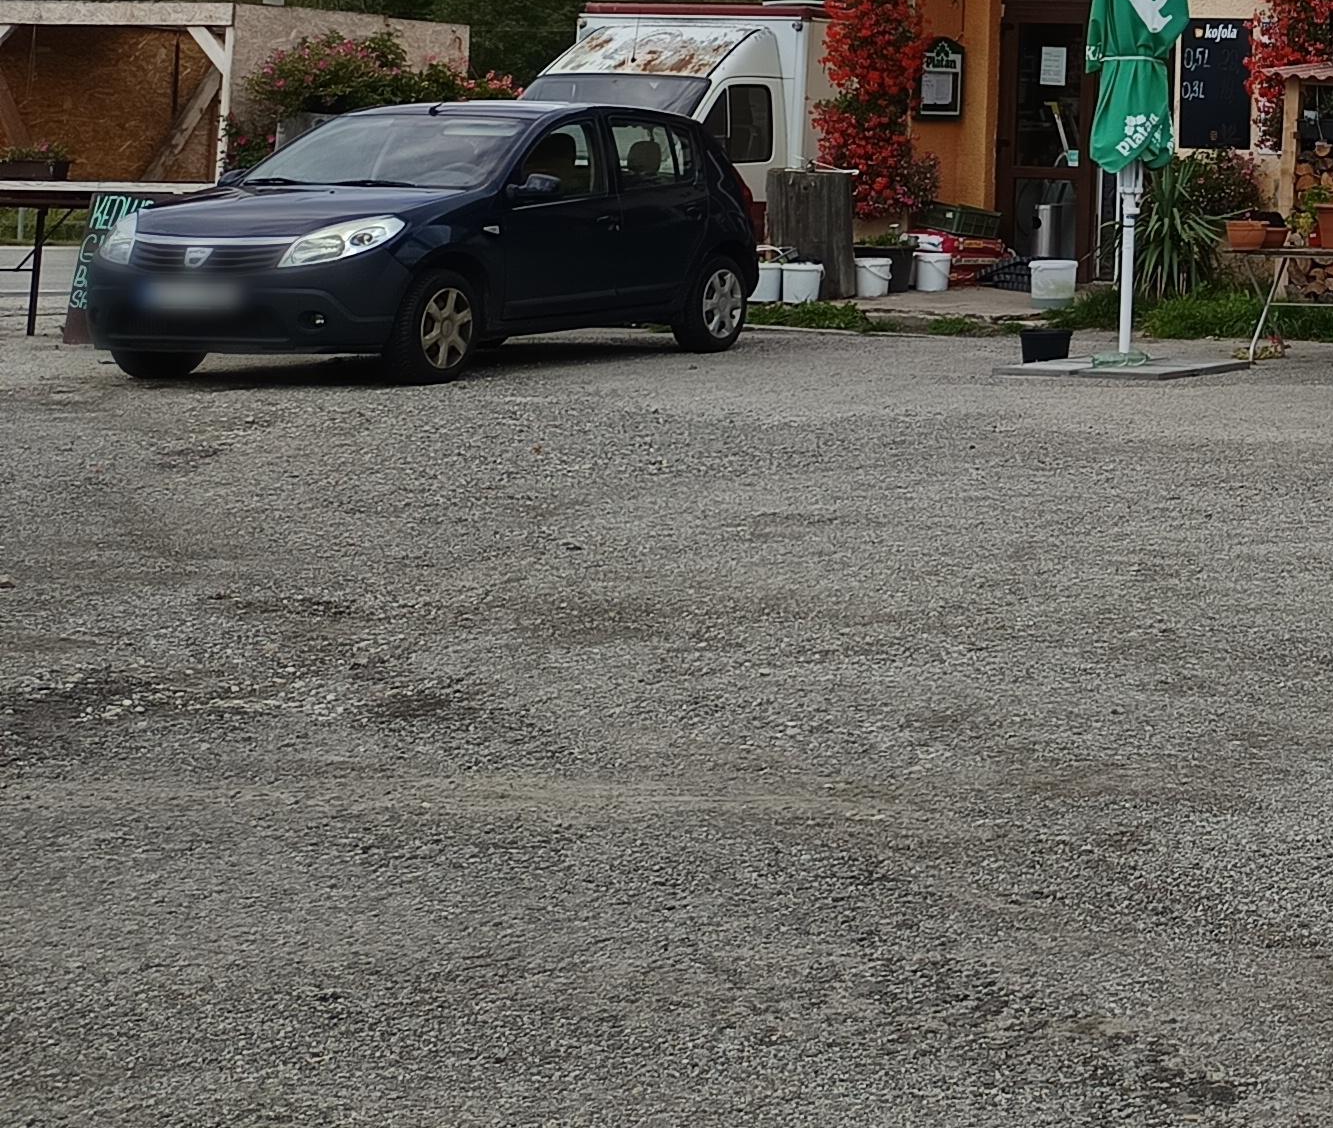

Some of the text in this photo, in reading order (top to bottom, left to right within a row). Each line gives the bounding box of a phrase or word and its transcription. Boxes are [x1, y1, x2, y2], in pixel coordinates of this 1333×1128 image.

[1204, 24, 1237, 42] kofola
[926, 56, 957, 69] Platan
[1115, 113, 1160, 156] Platan
